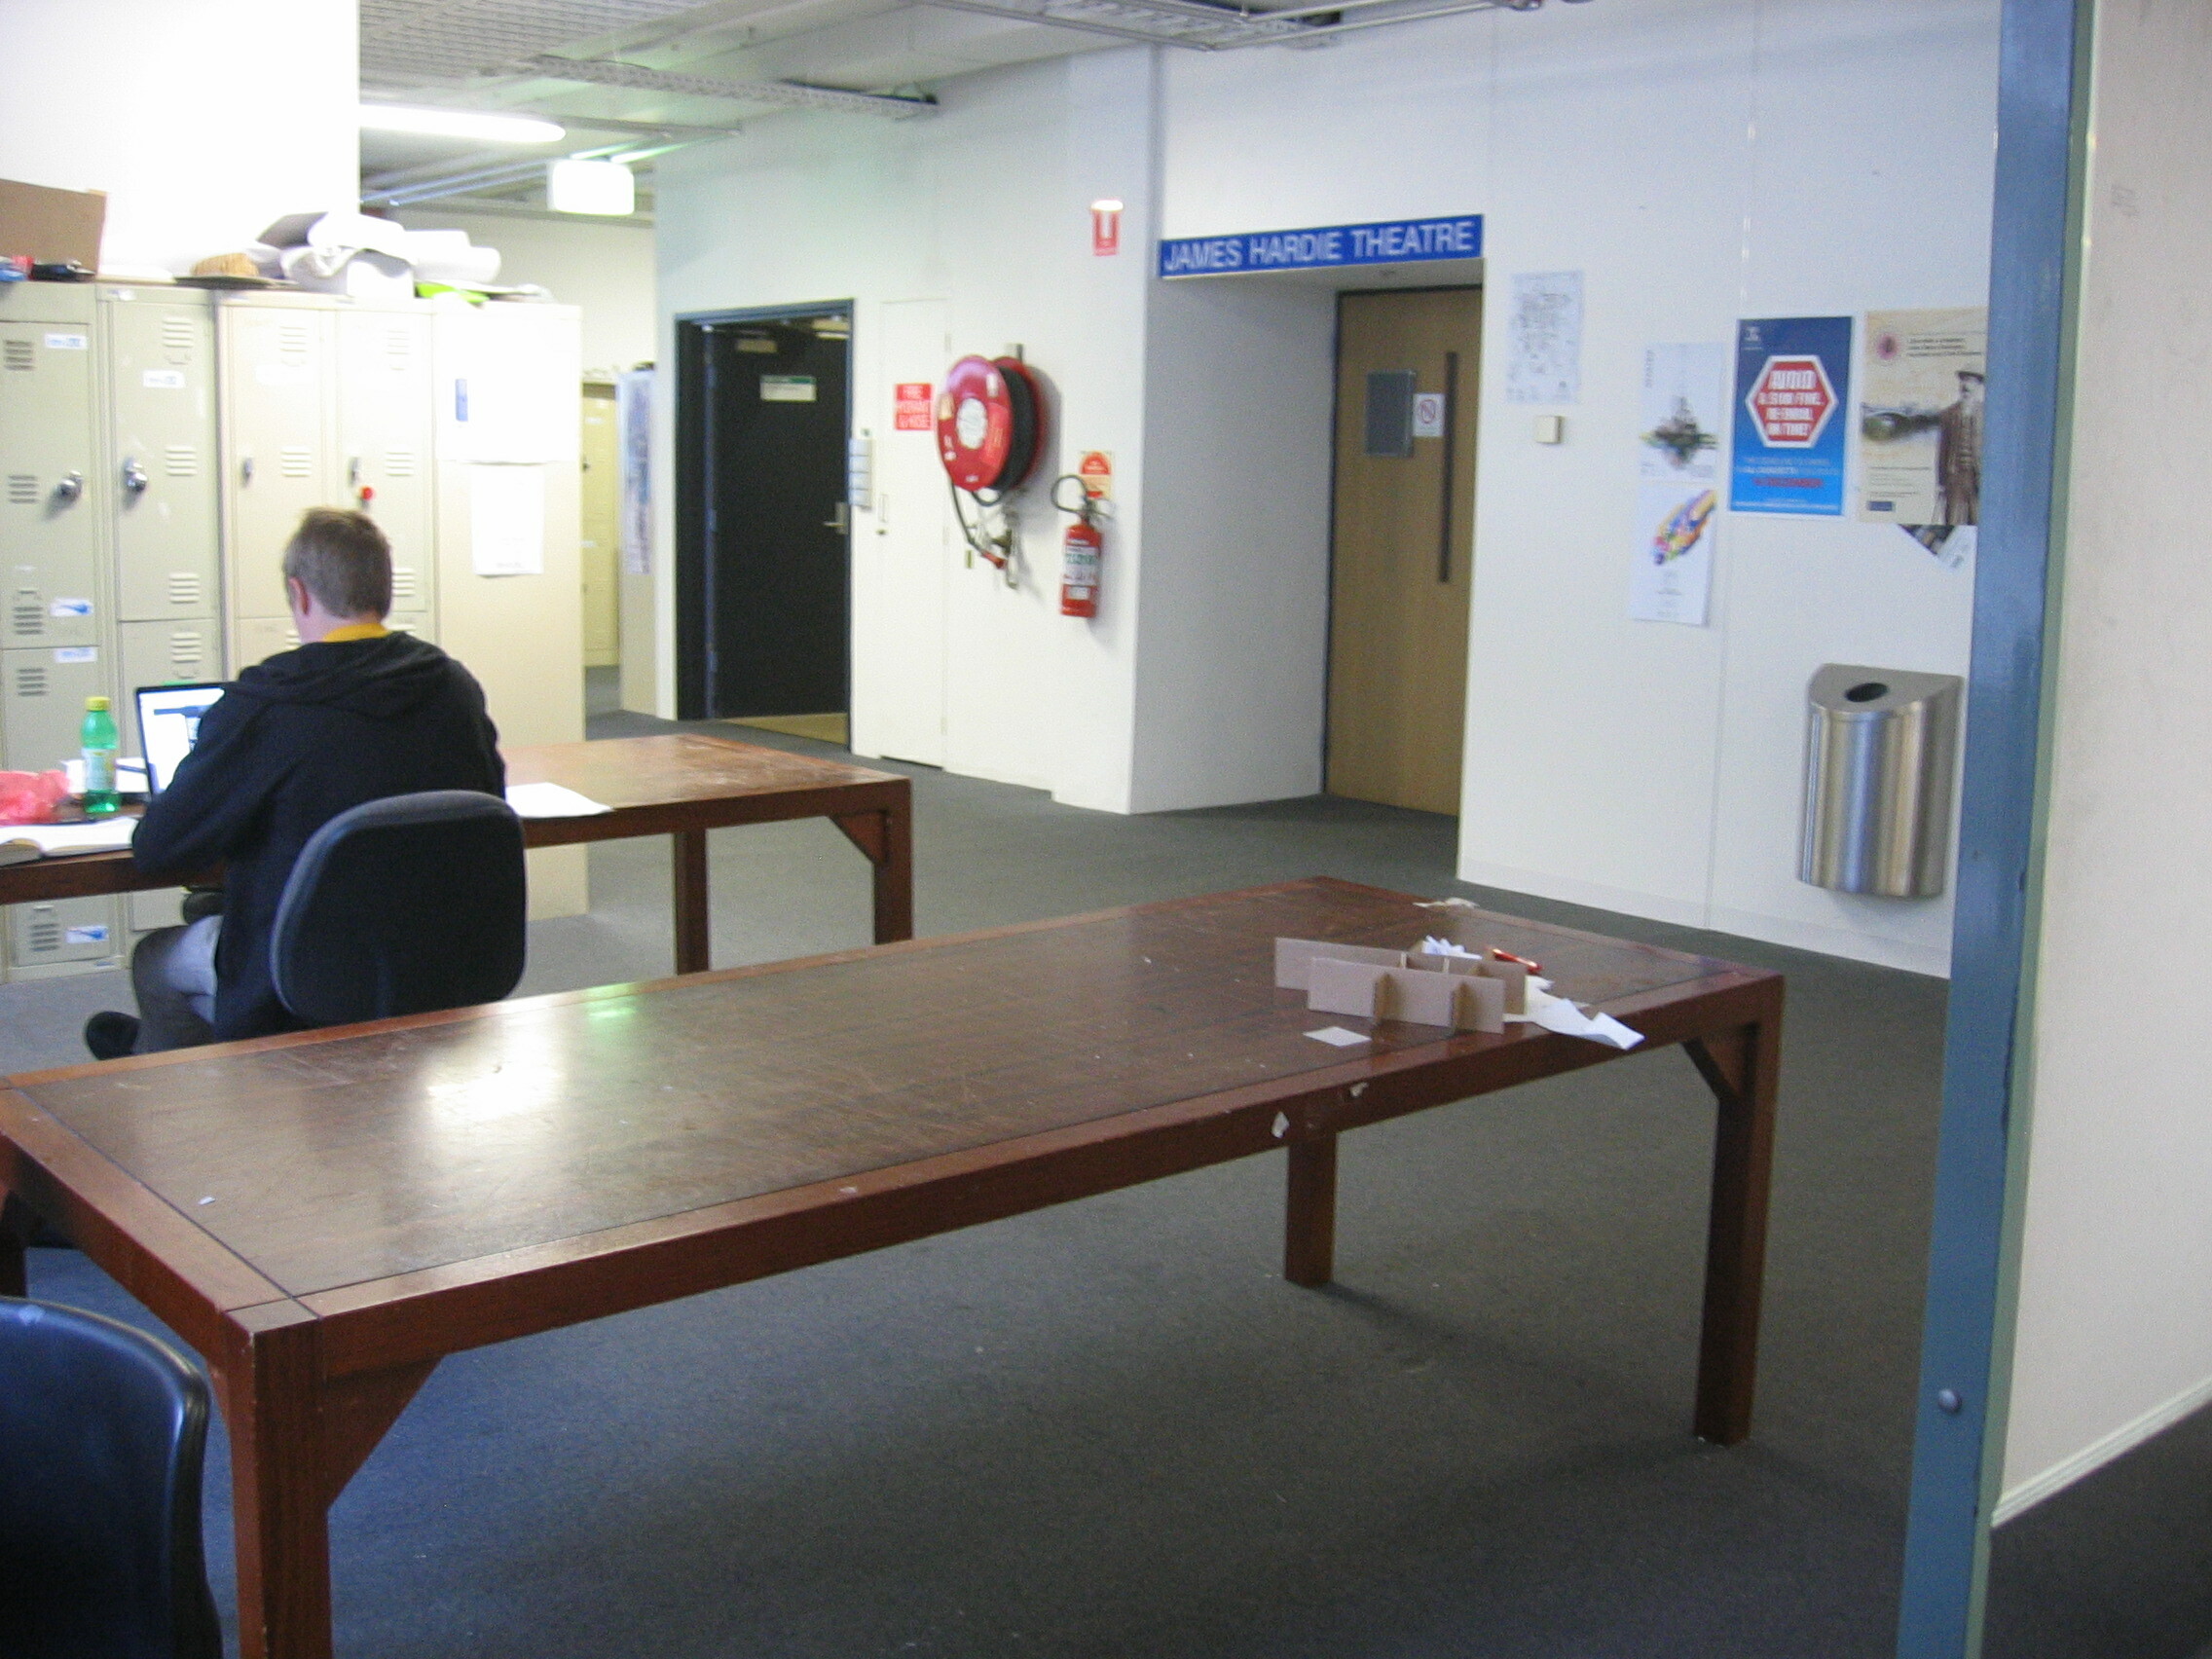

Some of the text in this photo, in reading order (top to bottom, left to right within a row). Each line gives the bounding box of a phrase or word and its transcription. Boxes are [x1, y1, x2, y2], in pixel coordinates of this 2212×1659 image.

[1163, 220, 1475, 272] JAMES HARDIE THEATRE
